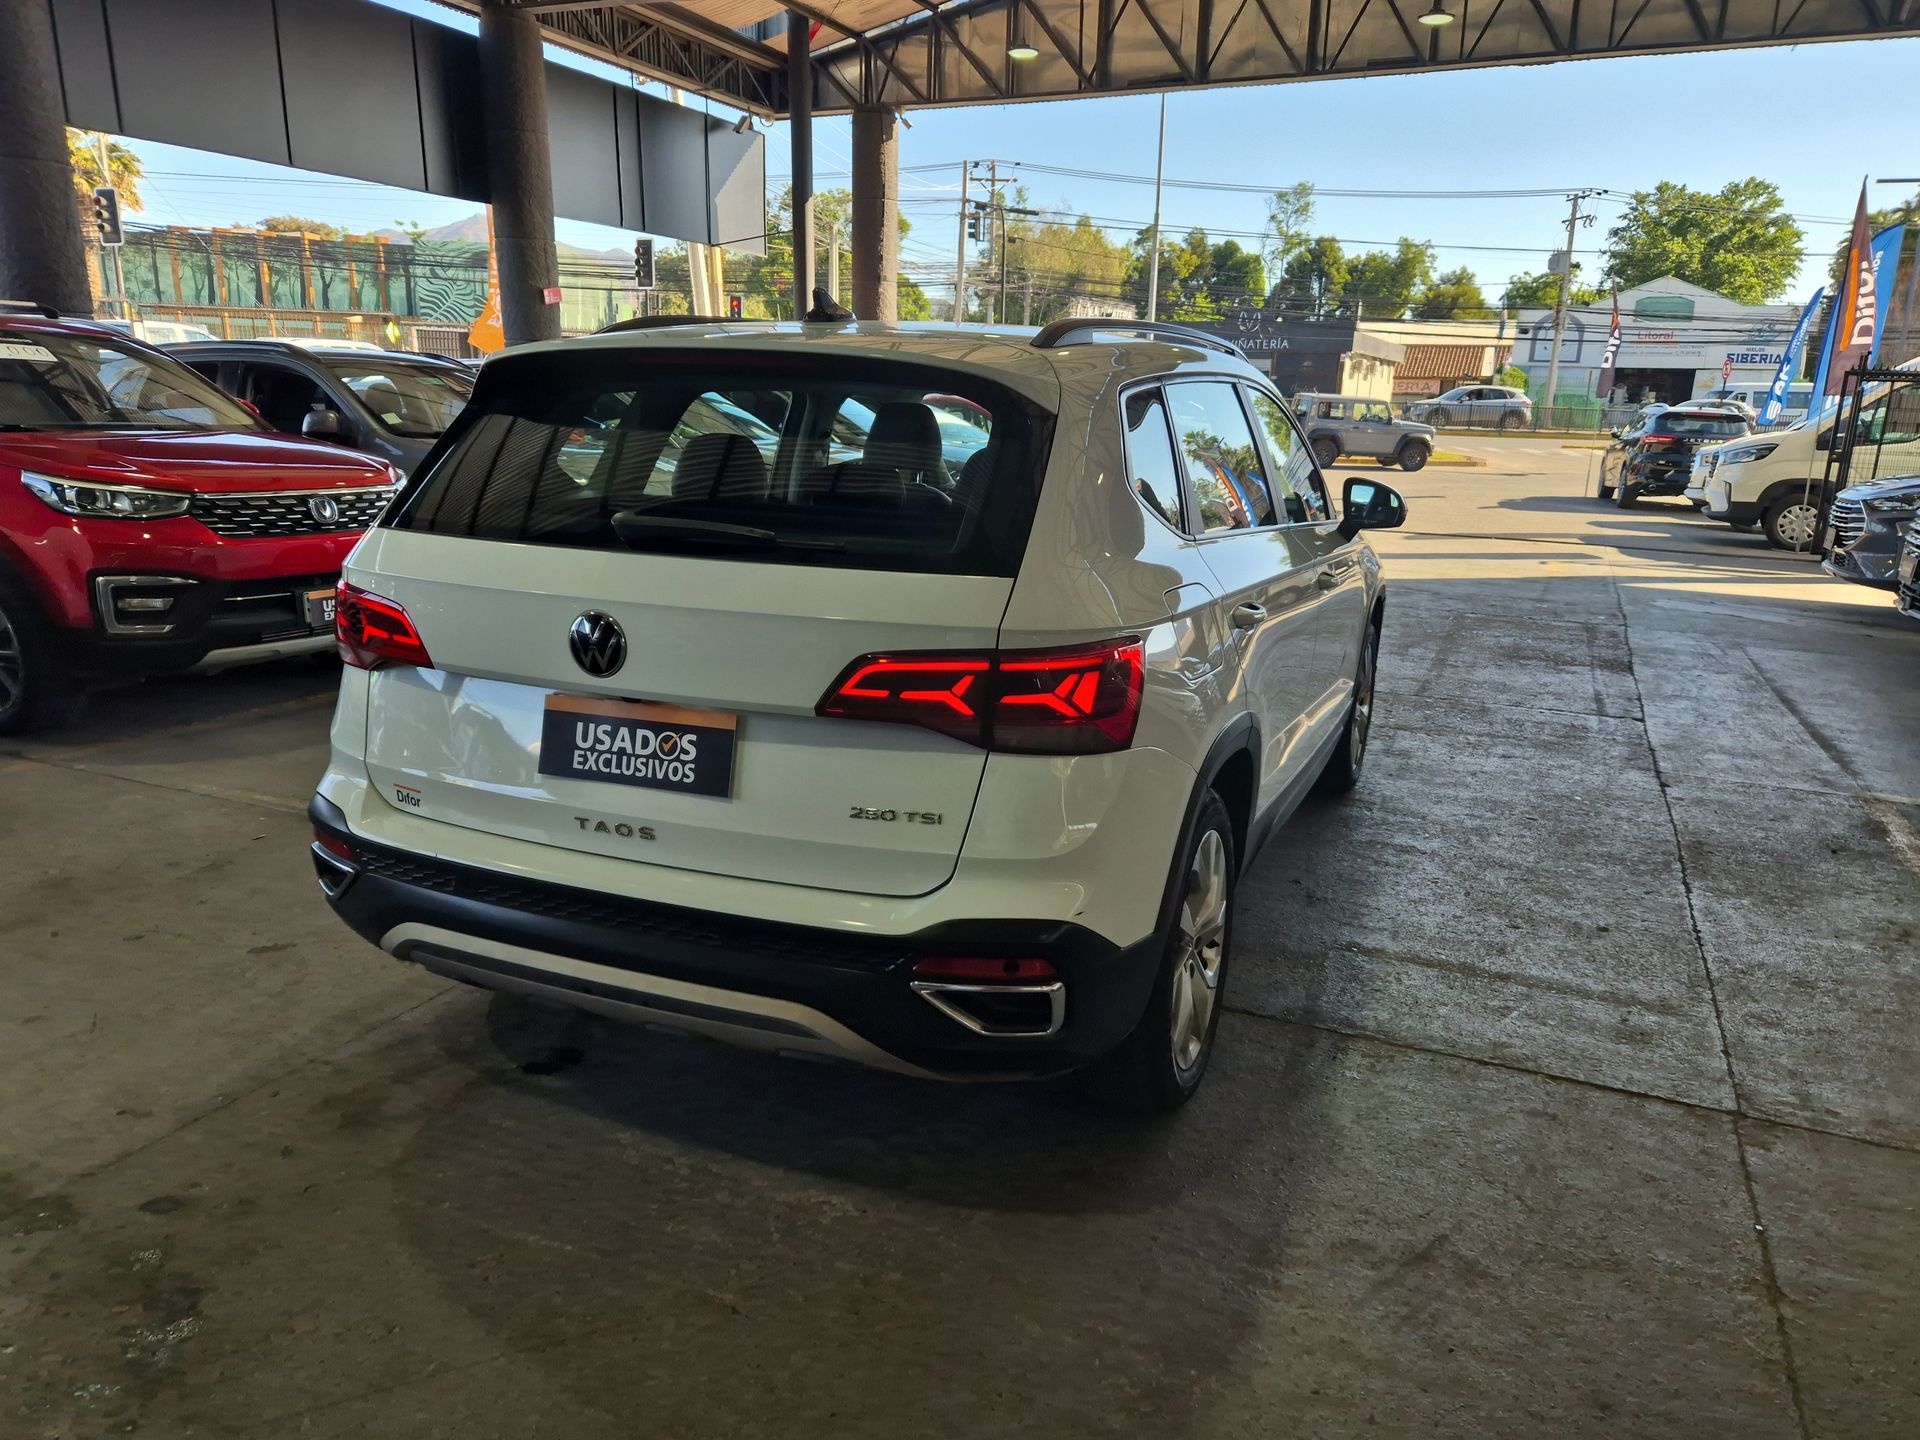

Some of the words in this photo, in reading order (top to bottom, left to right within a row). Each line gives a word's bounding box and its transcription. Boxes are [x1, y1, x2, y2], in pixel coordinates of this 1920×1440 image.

[1637, 331, 1674, 340] Litoral
[1726, 353, 1782, 364] SIBERIA
[575, 721, 698, 761] USADOS
[572, 750, 696, 783] EXCLUSIVOS
[396, 789, 421, 808] Difor
[849, 806, 897, 822] 250
[902, 810, 943, 826] TSI
[574, 816, 656, 841] TAOS
